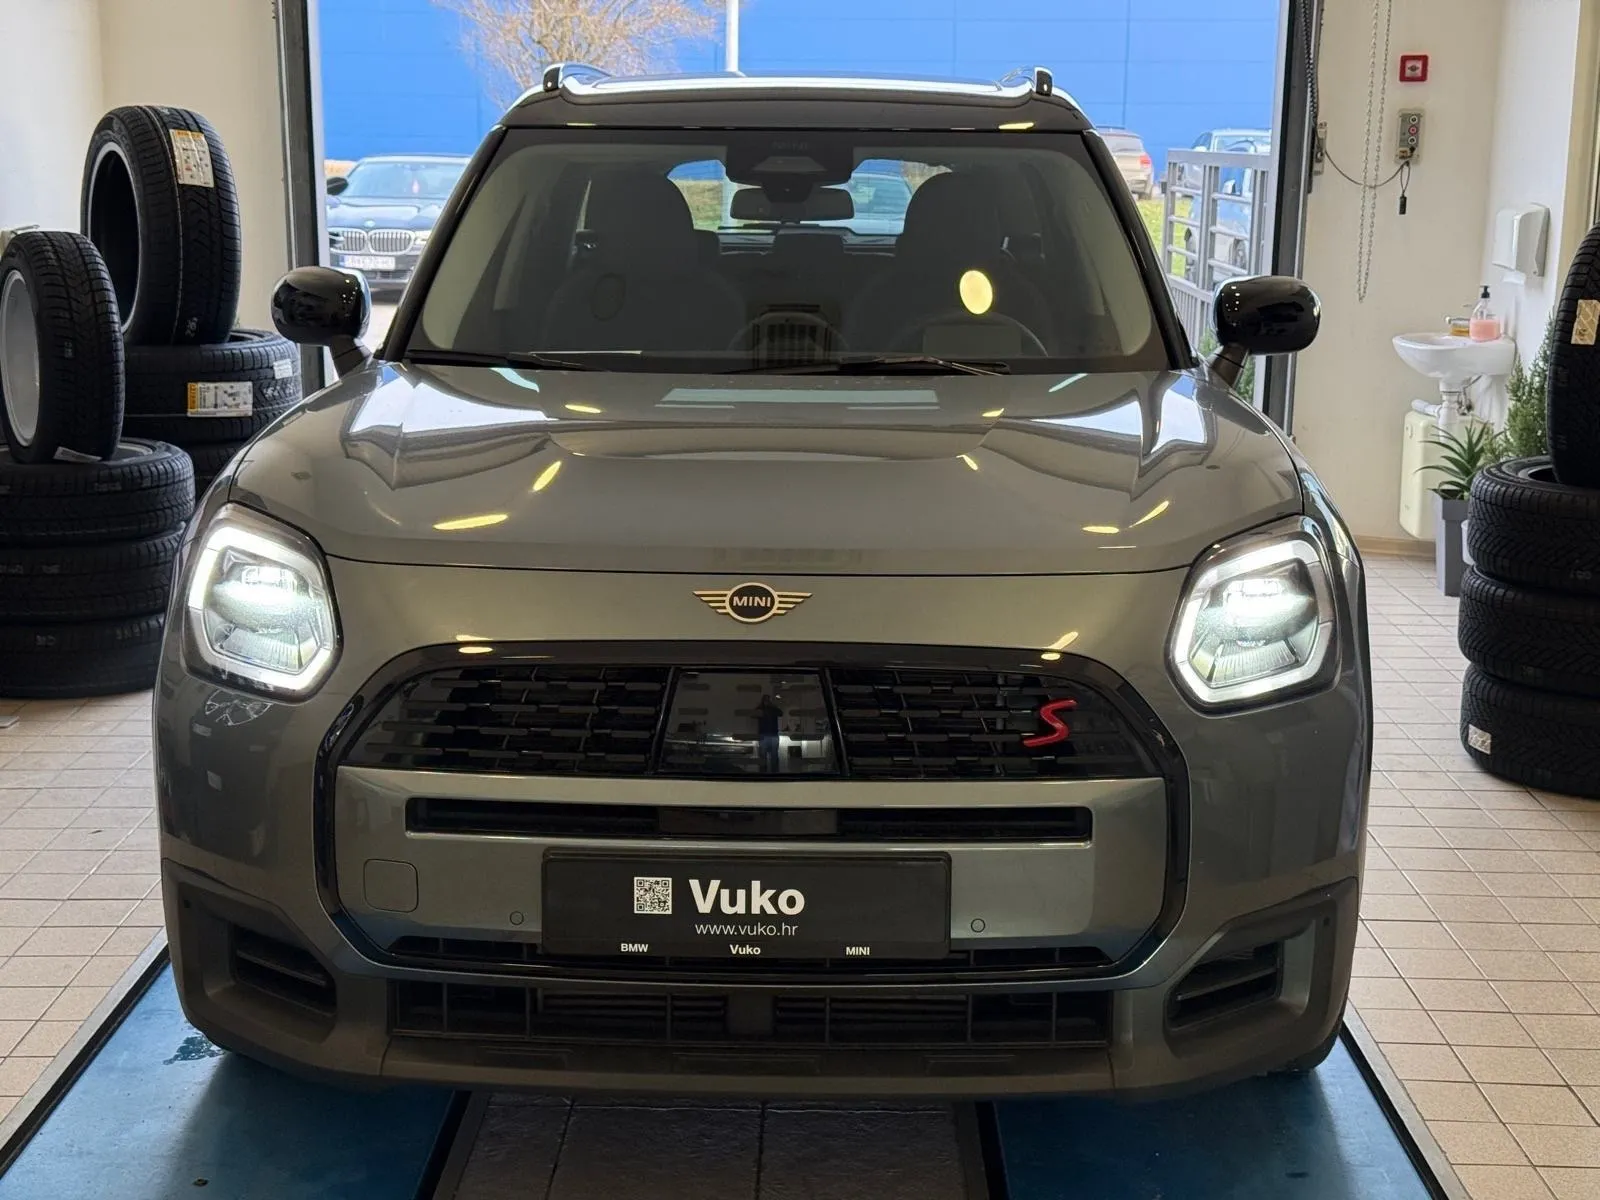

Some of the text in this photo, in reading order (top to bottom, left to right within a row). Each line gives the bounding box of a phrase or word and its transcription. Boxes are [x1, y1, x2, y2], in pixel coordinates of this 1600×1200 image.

[732, 595, 772, 608] MINI
[1023, 698, 1078, 747] S
[689, 879, 805, 916] Vuko
[695, 922, 798, 936] www.vuko.hr
[620, 943, 649, 953] BMW
[729, 944, 761, 955] Vuko
[845, 946, 871, 956] MINI
